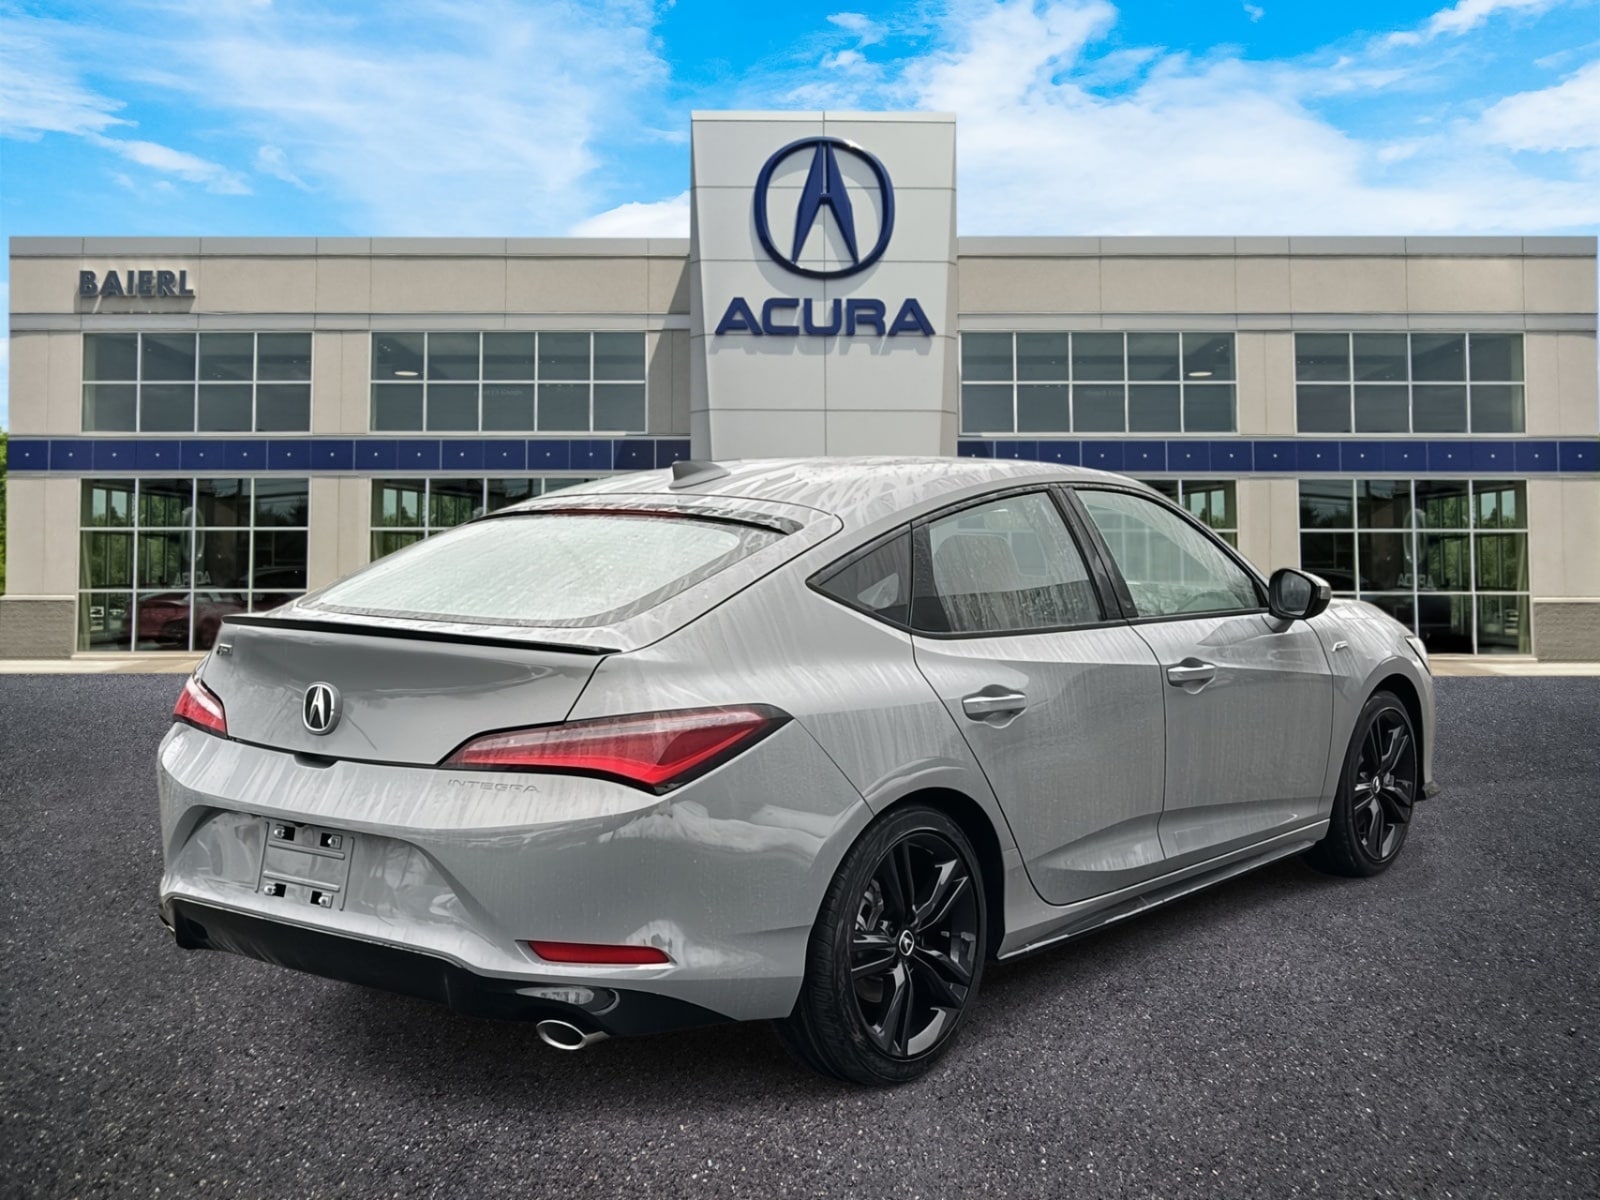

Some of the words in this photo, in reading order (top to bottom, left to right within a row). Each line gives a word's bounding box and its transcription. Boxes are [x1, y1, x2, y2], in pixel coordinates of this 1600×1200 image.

[78, 269, 195, 297] BAIERL
[714, 296, 936, 337] ACURA
[1397, 573, 1435, 588] ACRA
[448, 778, 542, 794] INTEGRA
